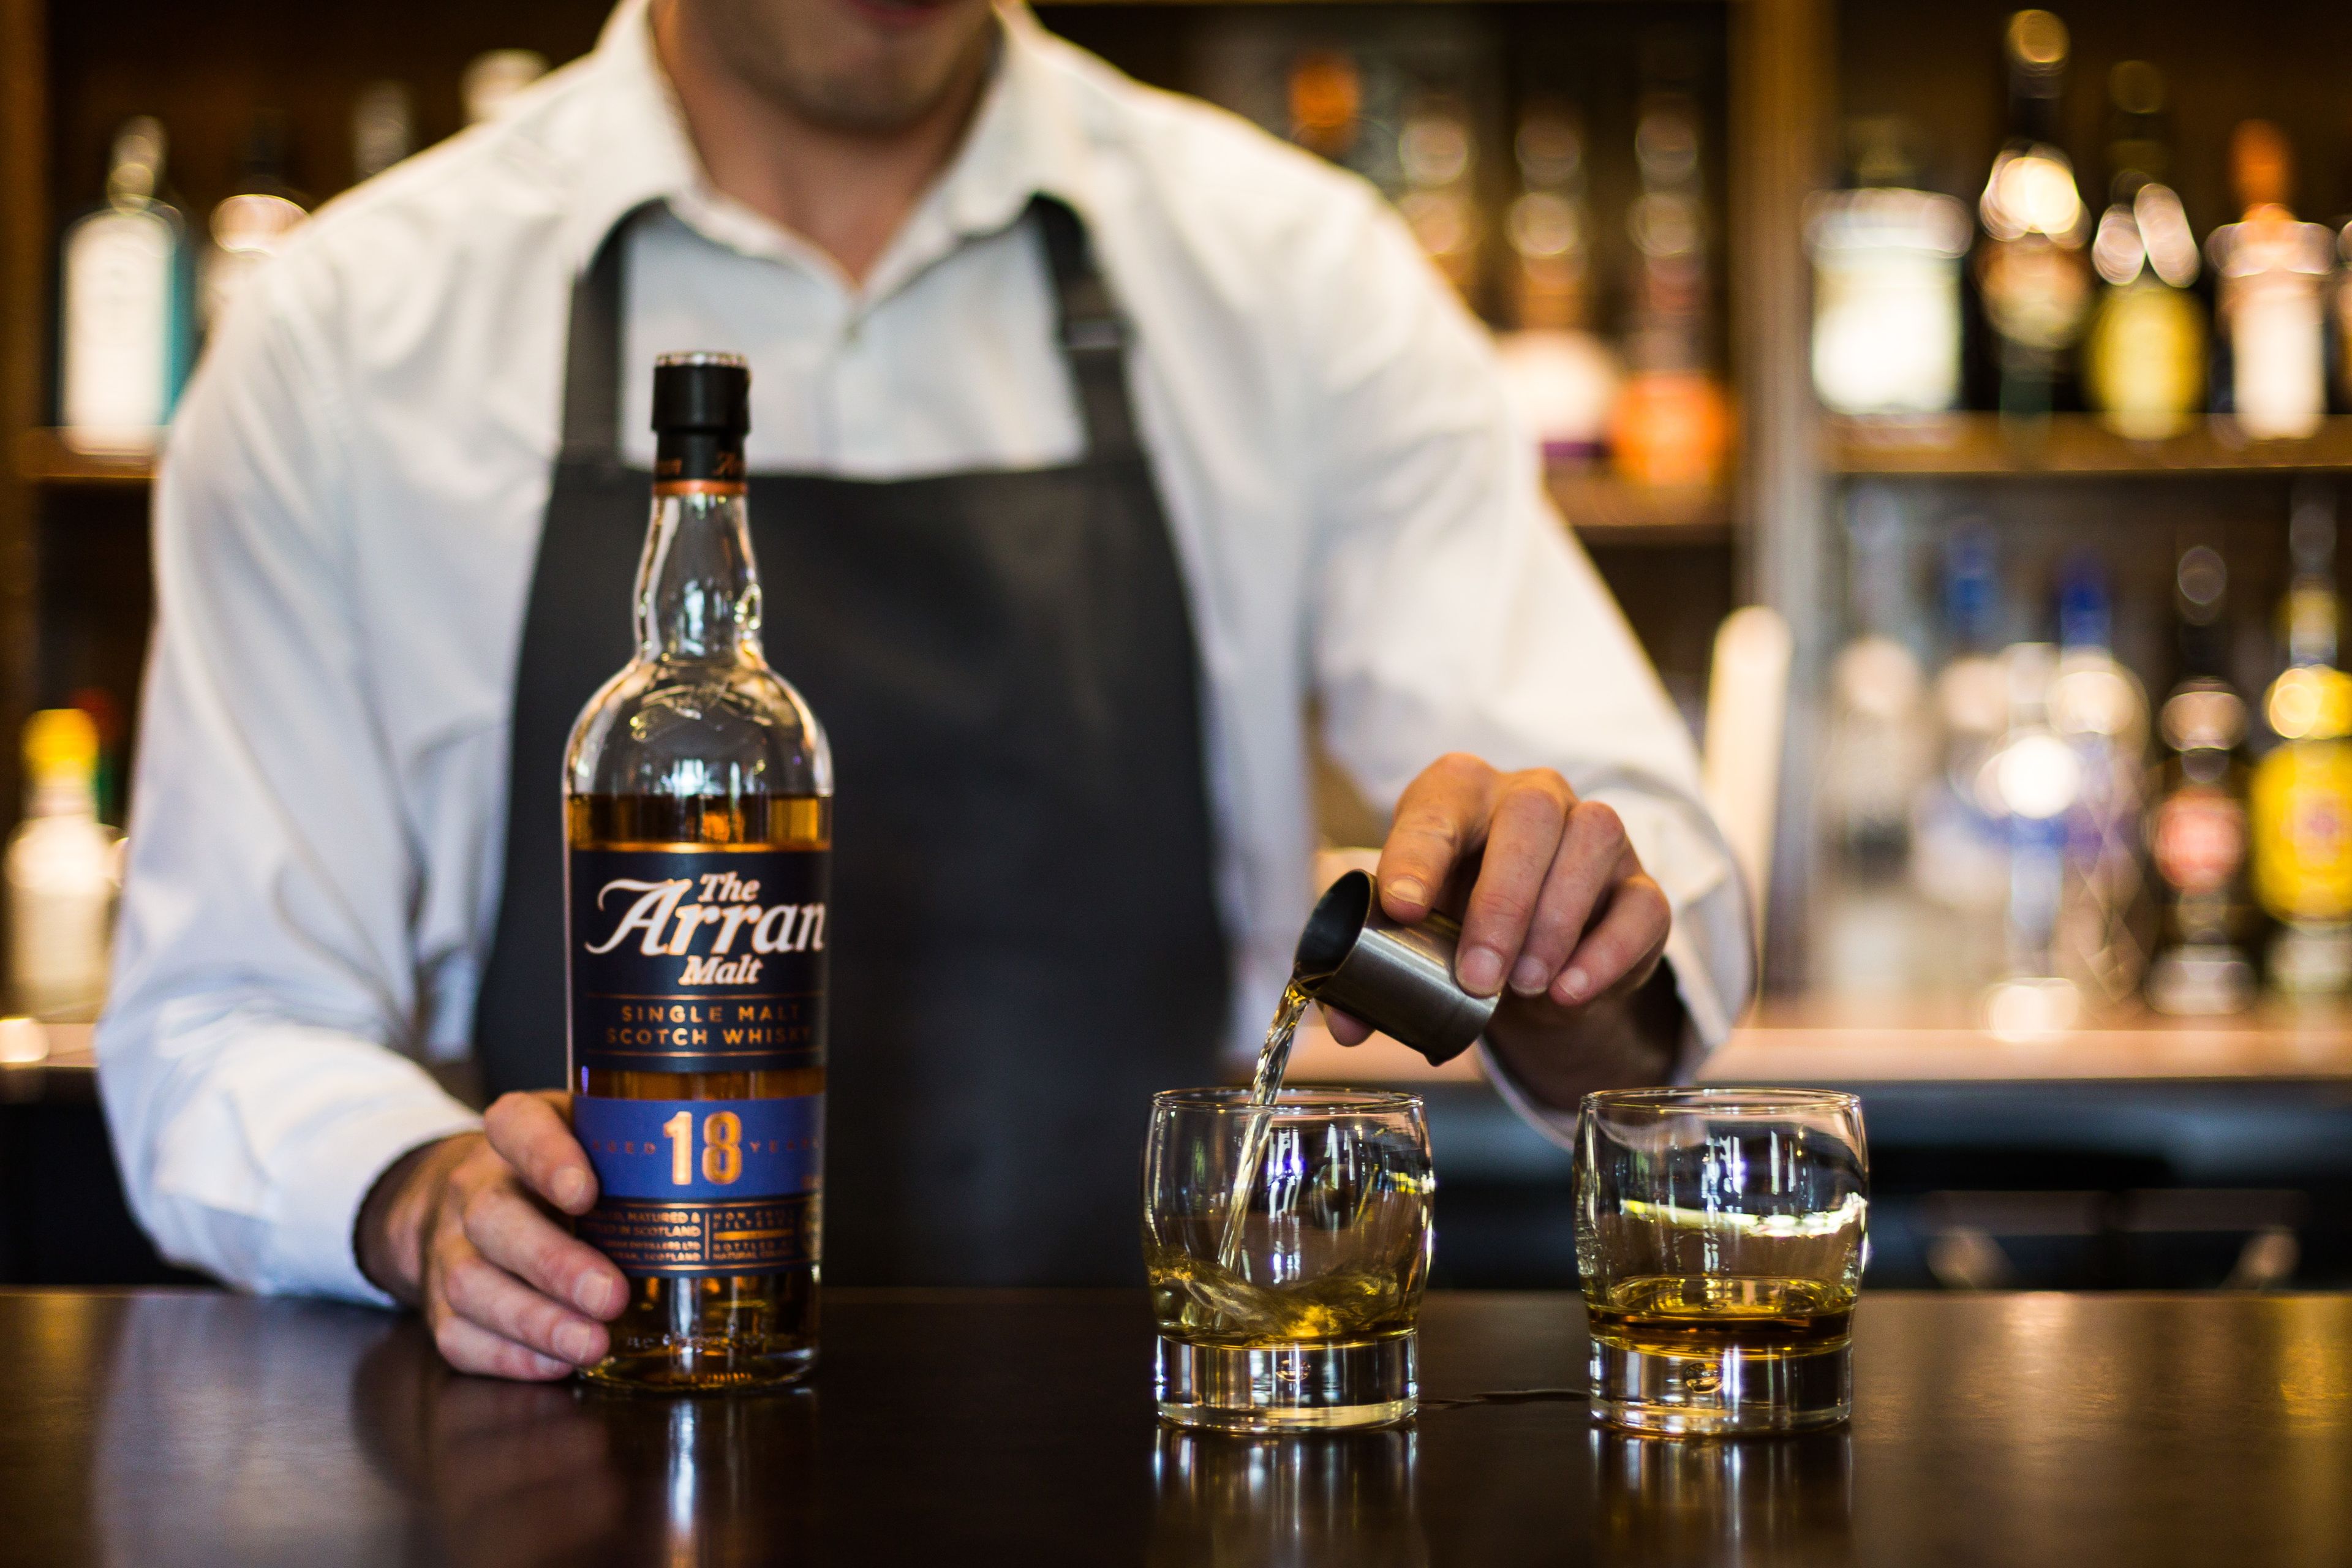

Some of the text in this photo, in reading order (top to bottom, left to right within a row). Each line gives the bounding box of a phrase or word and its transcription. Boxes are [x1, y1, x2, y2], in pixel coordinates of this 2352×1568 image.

[698, 871, 760, 902] The
[585, 878, 826, 956] Arran
[679, 953, 763, 986] Malt
[621, 1004, 799, 1023] SINGLE MALT
[606, 1027, 709, 1046] SCOTCH
[663, 1110, 743, 1185] 18
